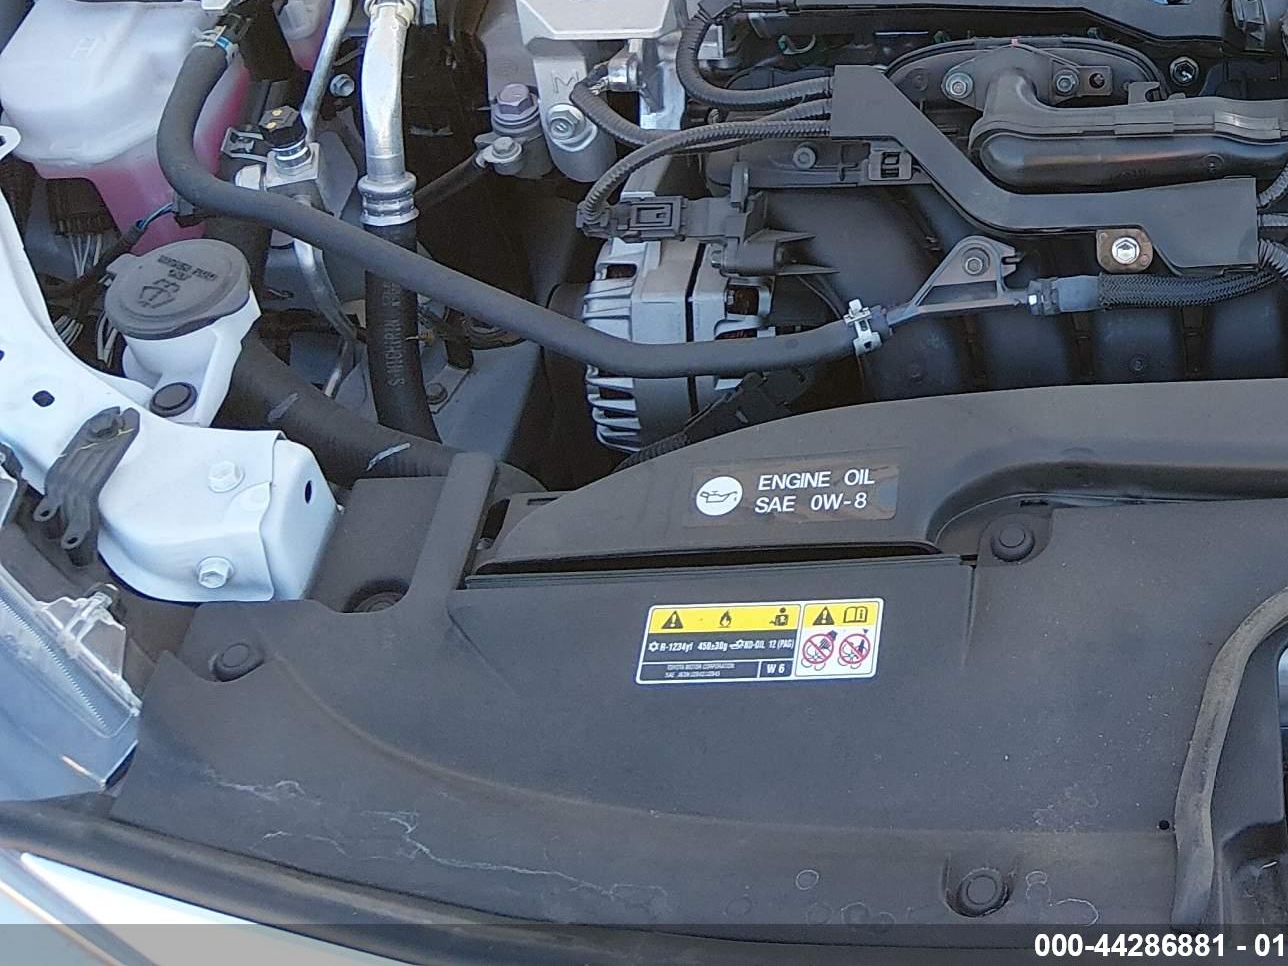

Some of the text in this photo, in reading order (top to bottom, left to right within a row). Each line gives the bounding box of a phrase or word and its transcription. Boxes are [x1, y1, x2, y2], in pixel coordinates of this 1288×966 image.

[758, 468, 876, 491] ENGINE OIL
[754, 492, 868, 513] SAE 0W-8
[659, 641, 694, 653] R-1234yf
[768, 639, 777, 649] 12
[777, 638, 795, 650] (PAG)
[767, 663, 786, 674] W 6
